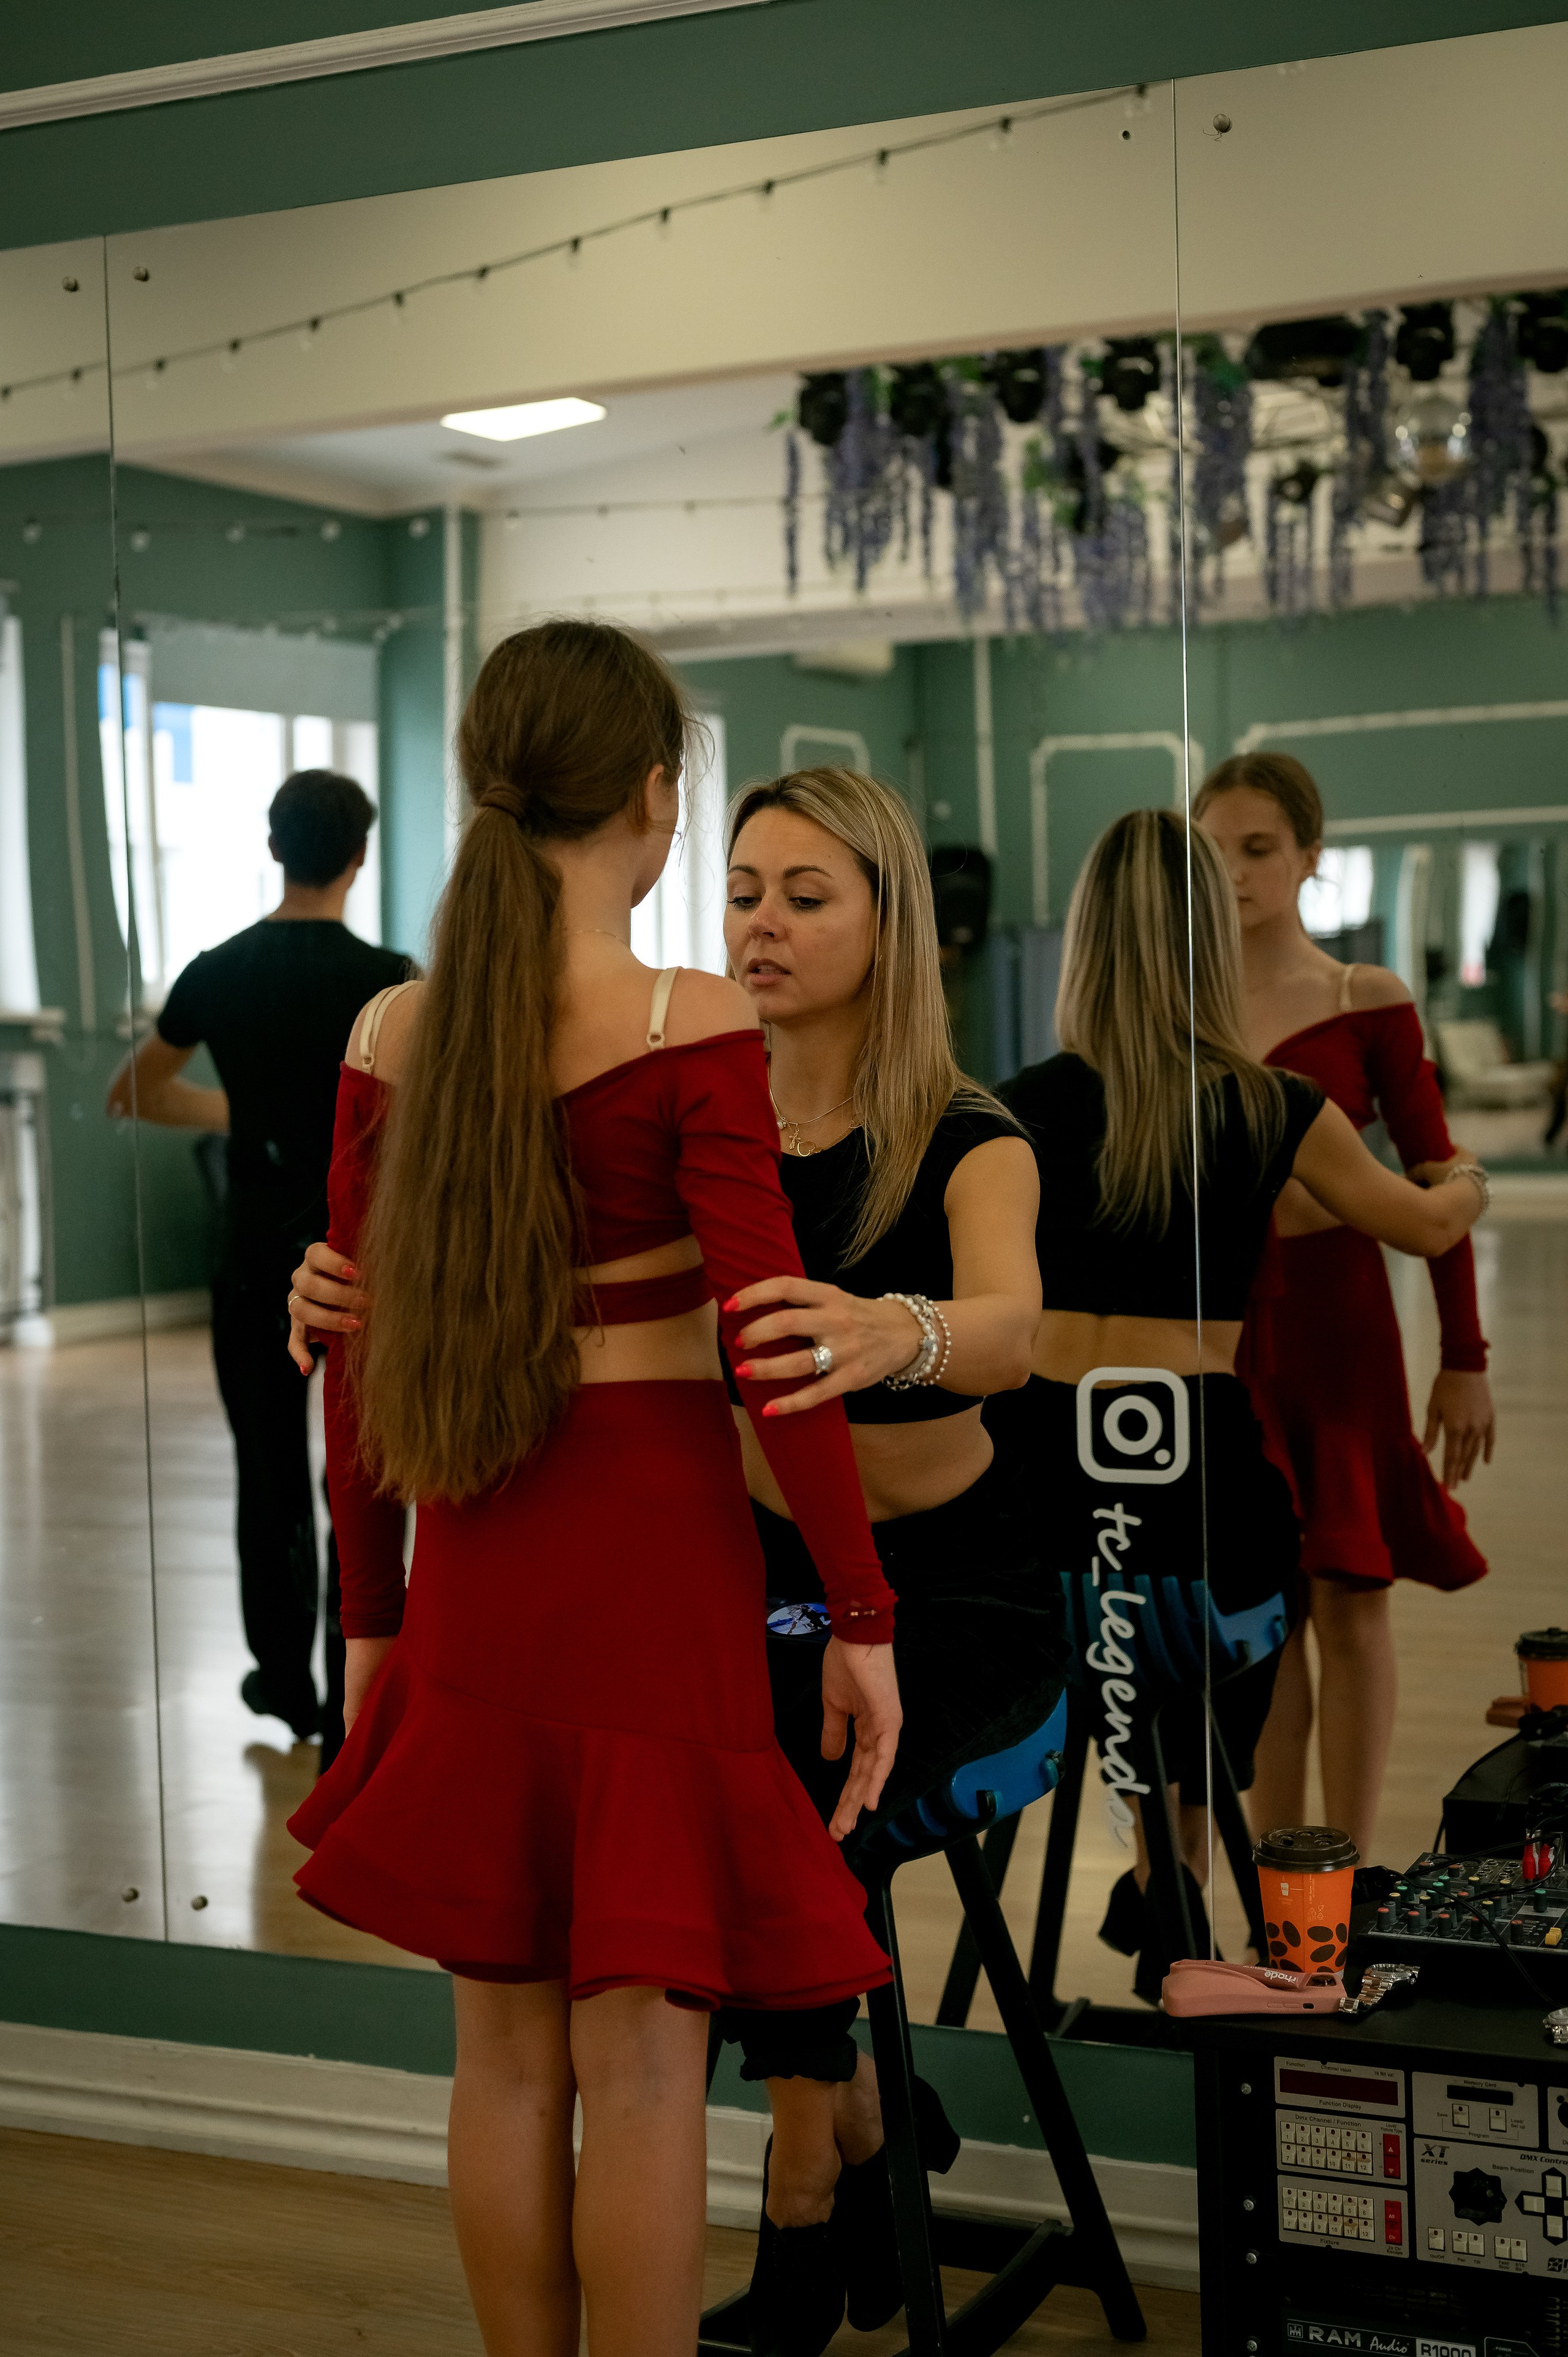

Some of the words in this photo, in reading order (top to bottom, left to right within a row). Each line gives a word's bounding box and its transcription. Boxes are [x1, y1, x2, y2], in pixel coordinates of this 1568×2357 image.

[1264, 1970, 1297, 1985] rhode
[1463, 2079, 1483, 2087] Memory
[1309, 2116, 1332, 2124] Channel
[1336, 2119, 1362, 2127] Function
[1420, 2143, 1450, 2158] XT
[1309, 2326, 1361, 2347] RAM
[1370, 2336, 1408, 2354] Audio
[1421, 2343, 1472, 2357] R1000
